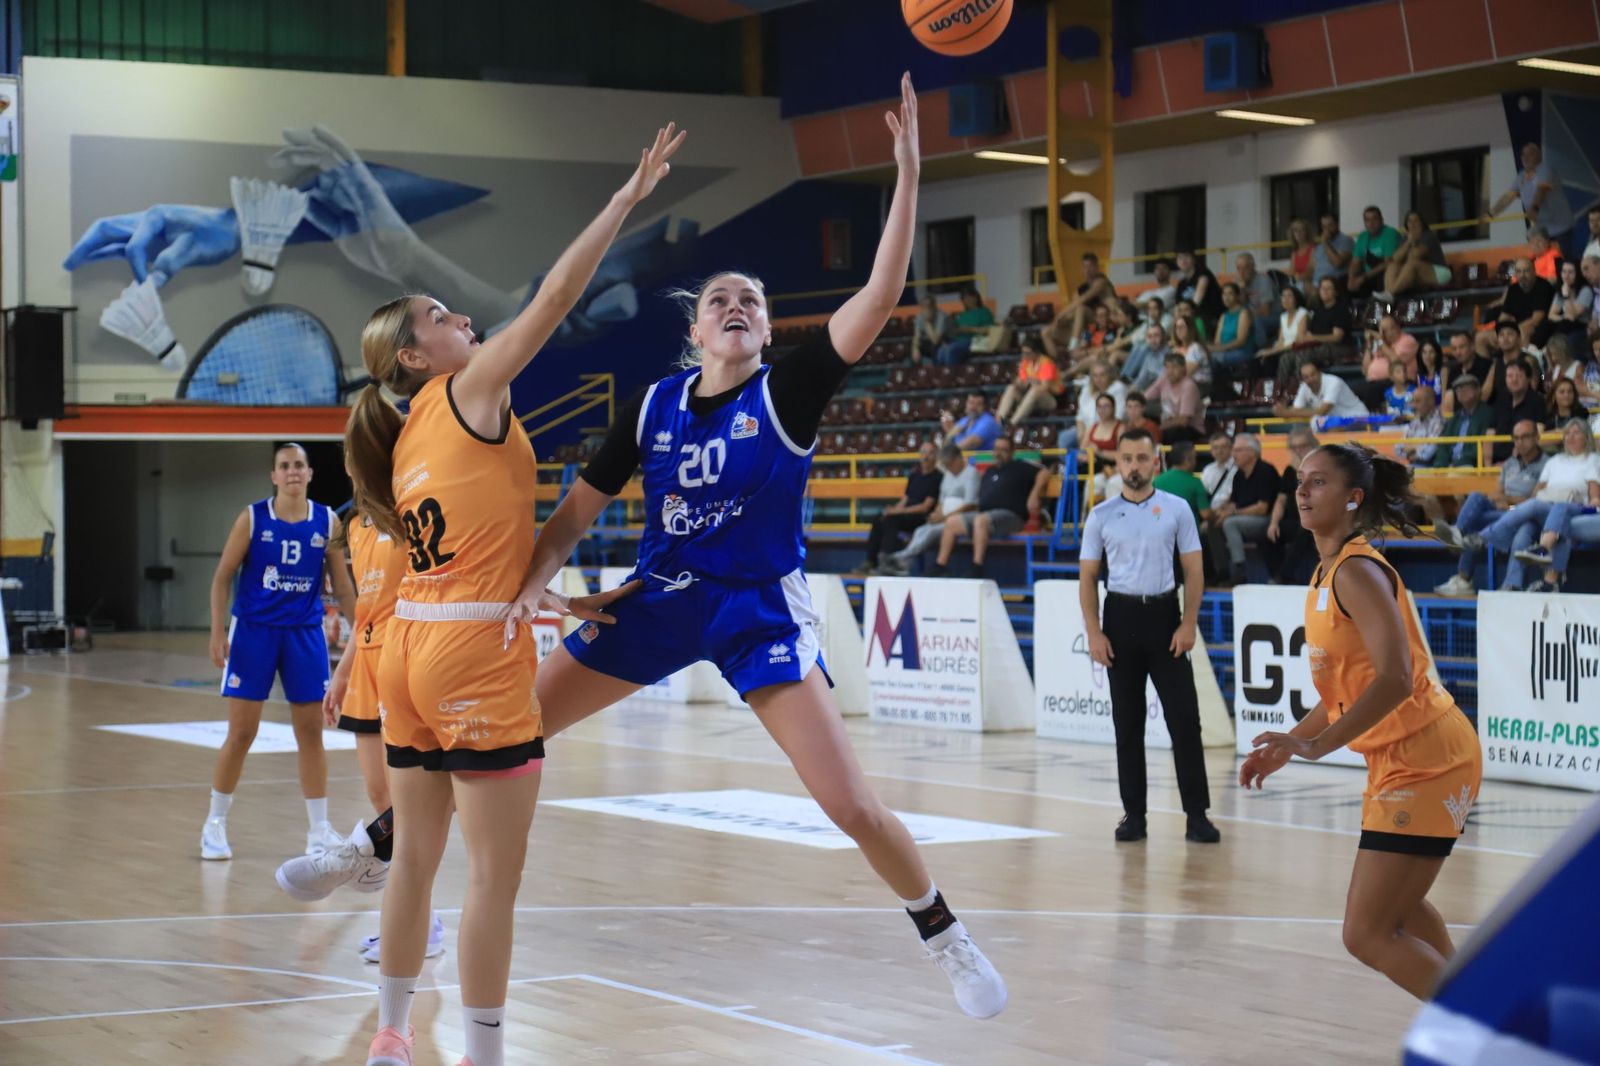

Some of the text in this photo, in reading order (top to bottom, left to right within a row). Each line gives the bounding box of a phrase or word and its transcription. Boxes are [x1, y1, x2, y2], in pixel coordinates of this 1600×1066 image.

[678, 437, 727, 488] 20
[281, 540, 302, 565] 13
[1242, 709, 1285, 724] GIMNASIO
